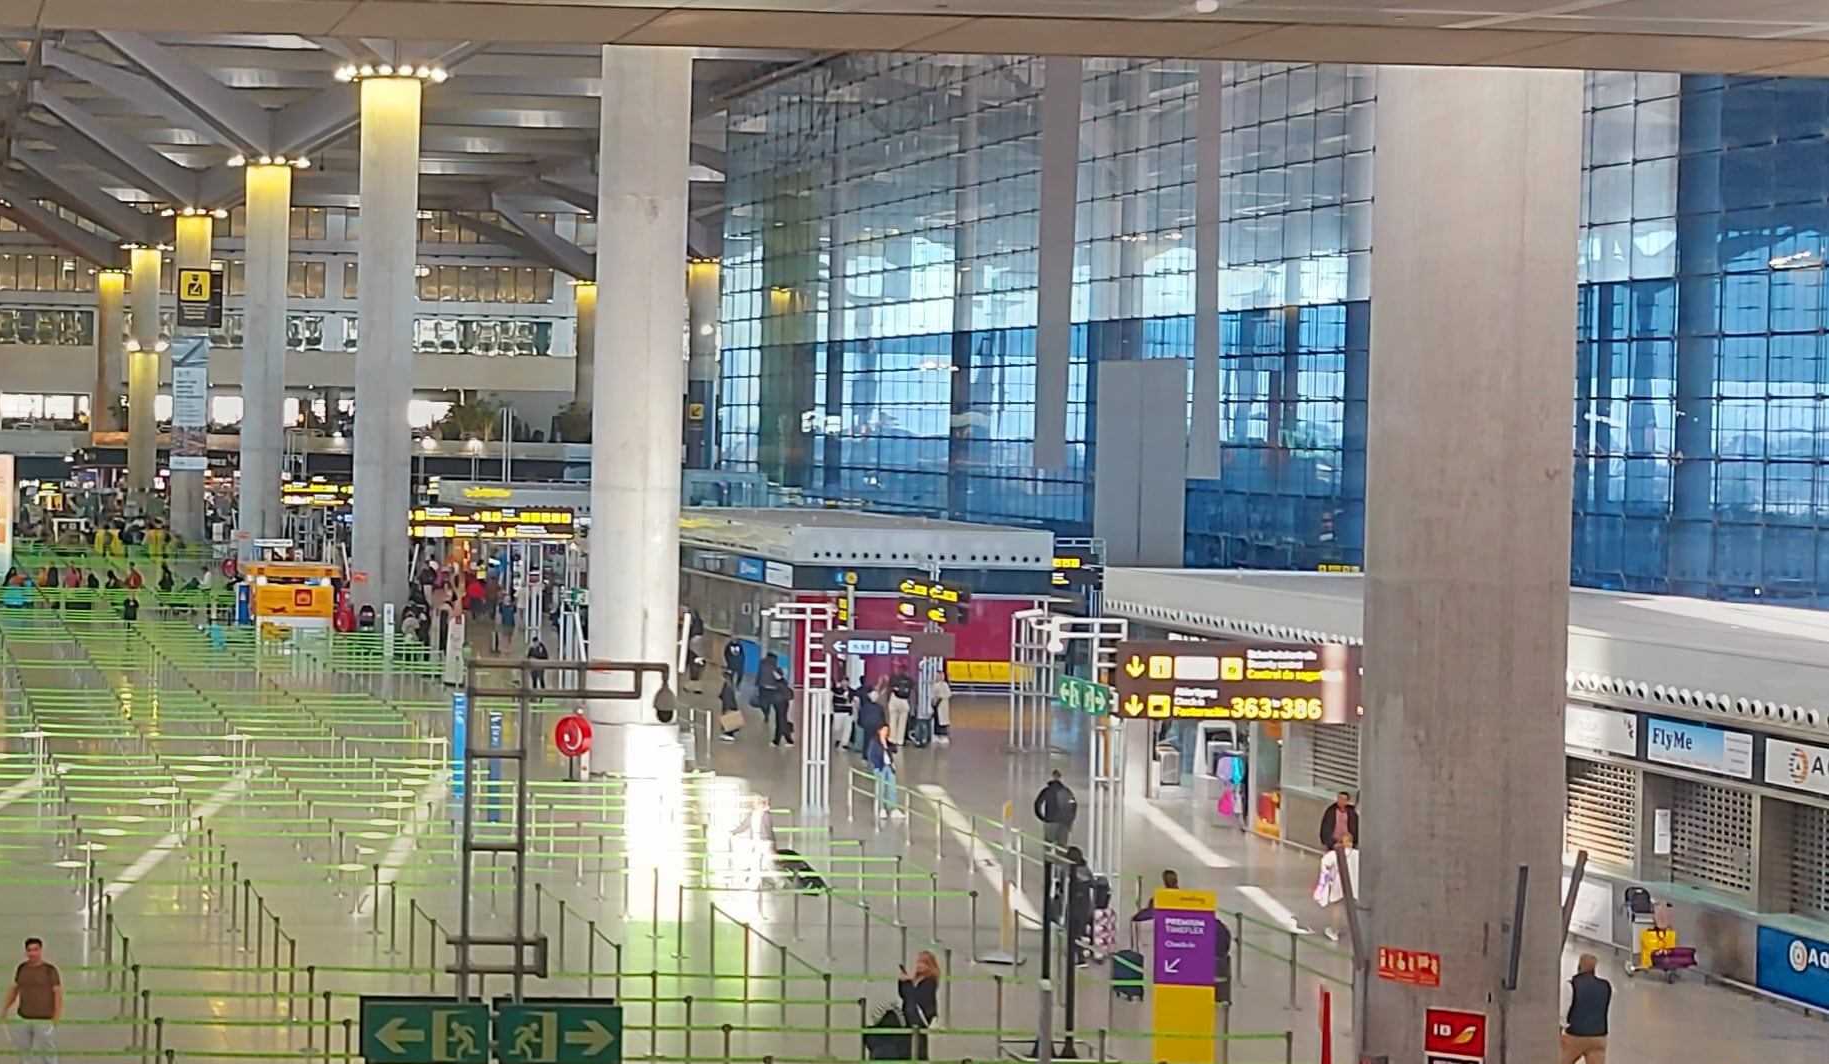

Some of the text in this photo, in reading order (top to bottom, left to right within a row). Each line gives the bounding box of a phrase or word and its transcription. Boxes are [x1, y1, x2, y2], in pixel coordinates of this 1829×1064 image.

[1231, 697, 1272, 718] 363
[1280, 697, 1322, 719] 386
[1652, 727, 1693, 751] FlyMe
[1433, 1023, 1452, 1036] IB
